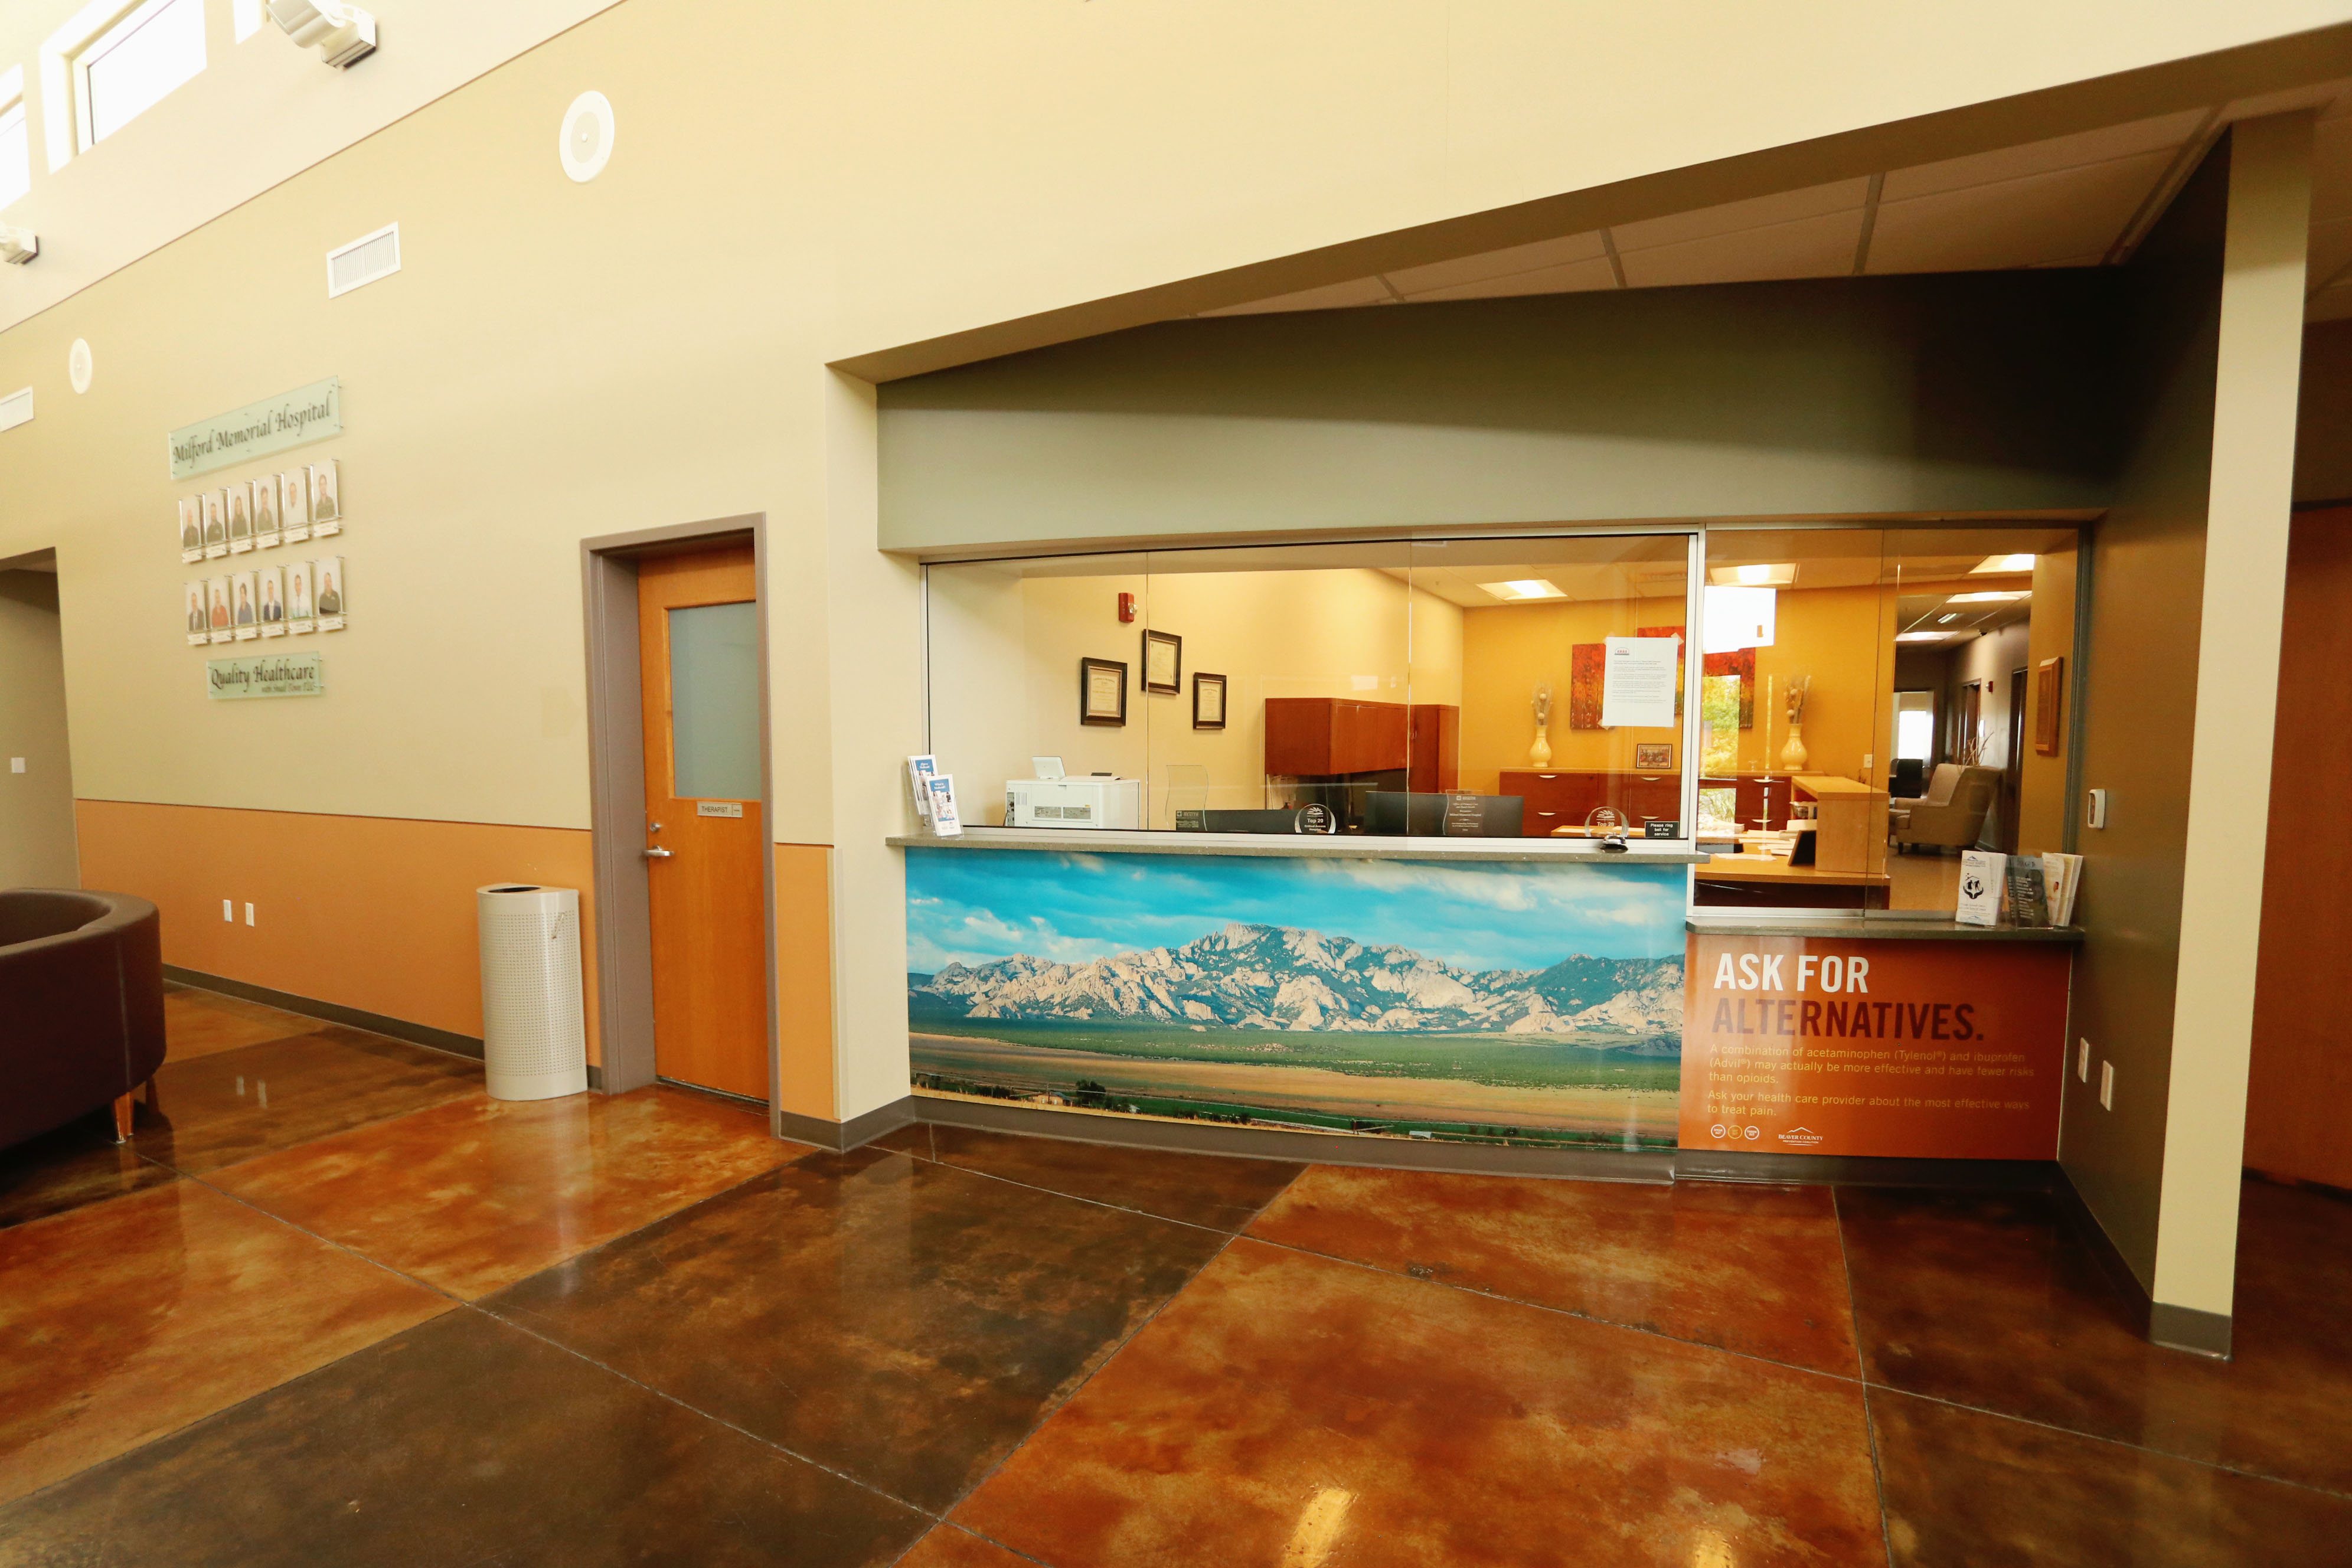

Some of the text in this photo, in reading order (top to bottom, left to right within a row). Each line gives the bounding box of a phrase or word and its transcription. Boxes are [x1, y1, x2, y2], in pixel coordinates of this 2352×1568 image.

[173, 390, 332, 469] Milford Memorial Hospital
[211, 659, 315, 692] Quality Healthcare
[1713, 953, 1869, 994] ASK FOR
[1712, 998, 1984, 1040] ALTERNATIVES.
[1710, 1044, 1718, 1054] A
[1721, 1046, 1789, 1057] combination
[1792, 1047, 1804, 1057] of
[1807, 1048, 1890, 1060] acetaminophen
[1949, 1051, 1970, 1061] and
[1974, 1052, 2026, 1063] ibuprofen
[1709, 1072, 1779, 1084] than opioids.
[1755, 1061, 1777, 1072] may
[1781, 1061, 1823, 1073] actually
[1827, 1062, 1840, 1072] be
[1844, 1064, 1871, 1073] more
[1874, 1064, 1921, 1074] effective
[1925, 1066, 1945, 1074] and
[1949, 1066, 1974, 1076] have
[1978, 1066, 2006, 1076] fewer
[2009, 1067, 2034, 1077] risks
[1707, 1090, 2030, 1110] Ask your health care provider about the most effective ways
[1707, 1105, 1776, 1117] to treat pain.
